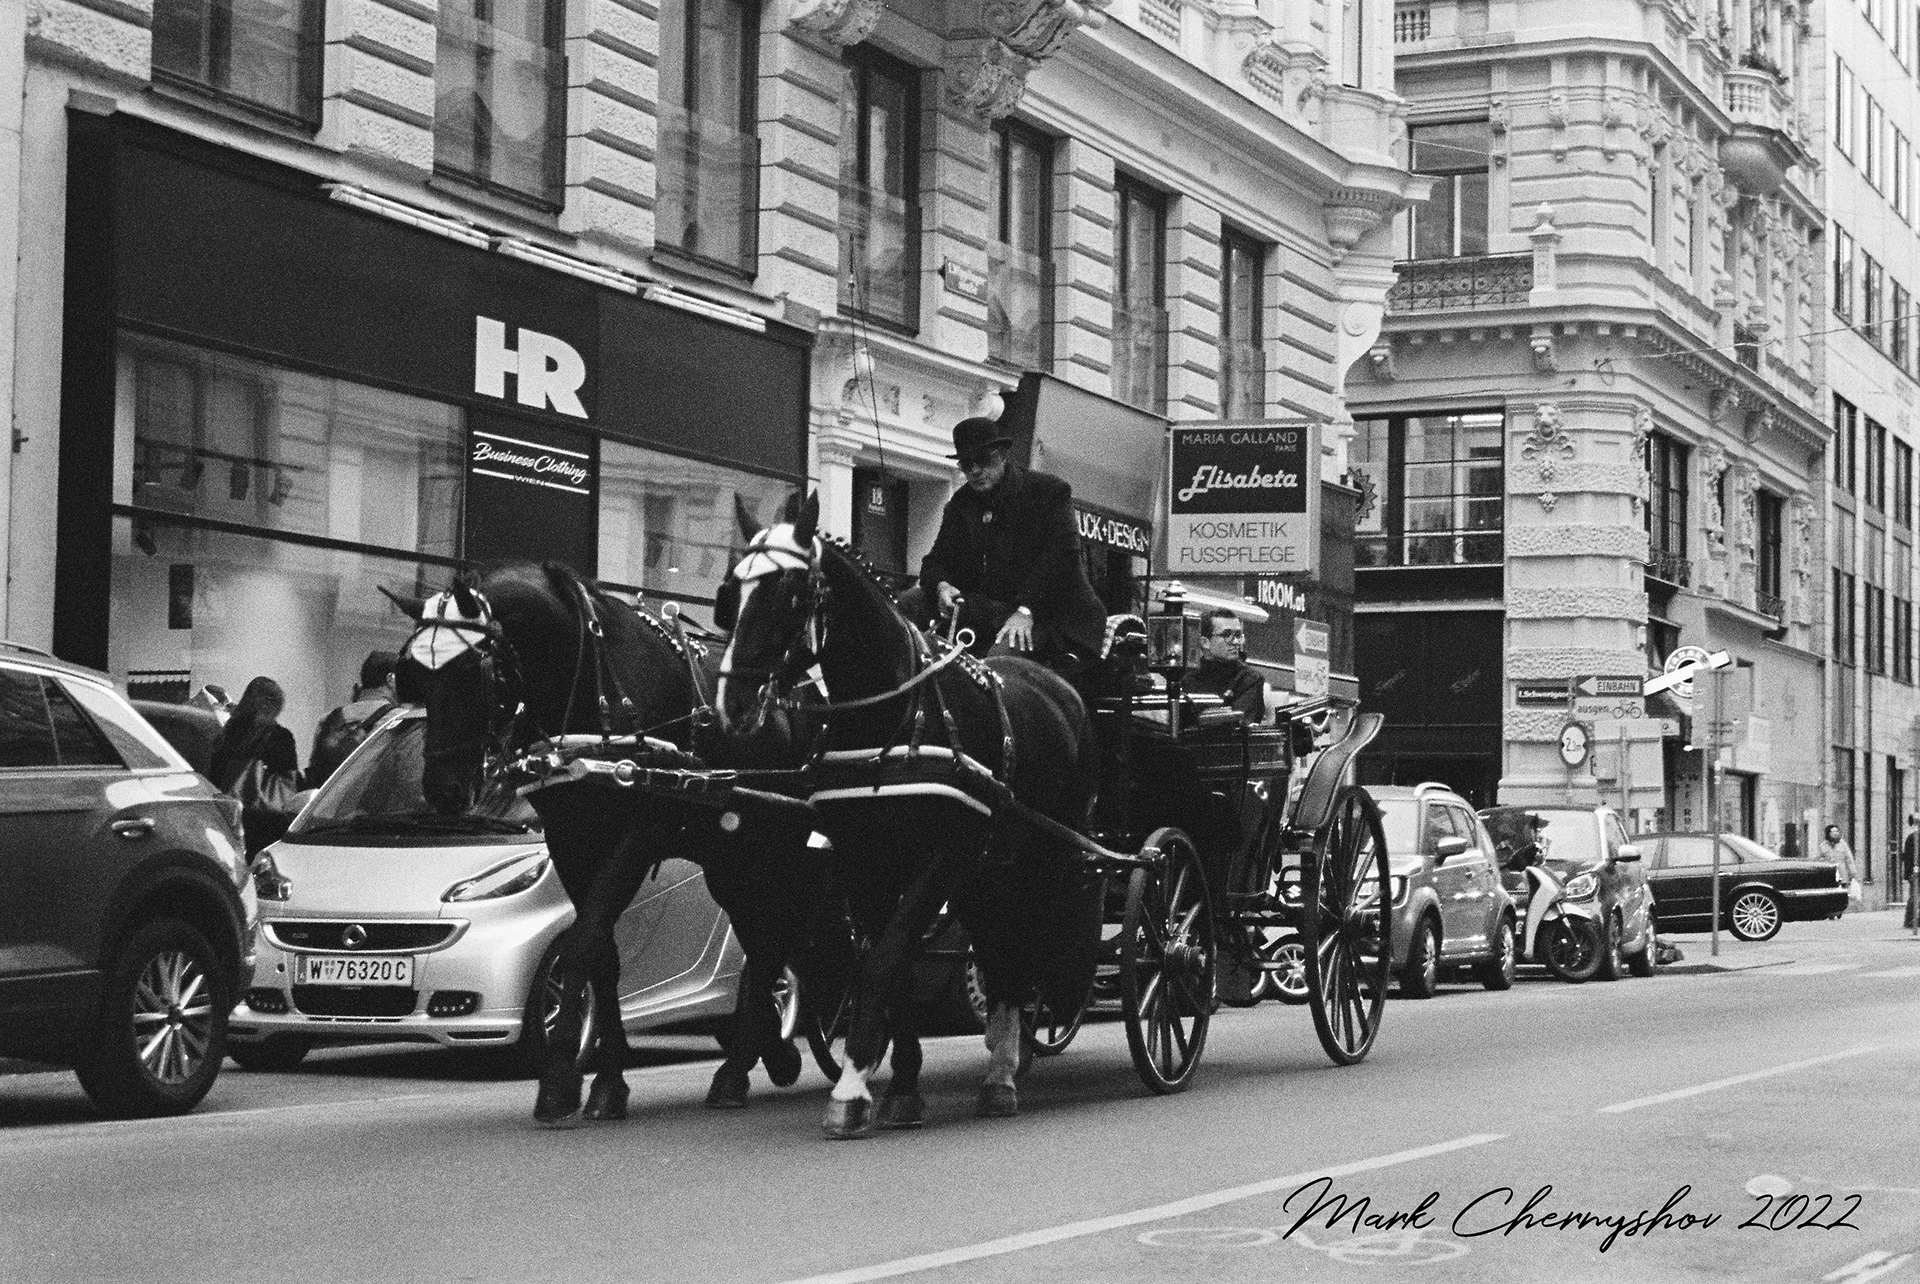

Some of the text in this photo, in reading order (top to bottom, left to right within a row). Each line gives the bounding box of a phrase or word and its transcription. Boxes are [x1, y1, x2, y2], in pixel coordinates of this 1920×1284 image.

[475, 315, 588, 419] HR
[1182, 431, 1298, 445] MARIA GALLAND
[472, 442, 589, 484] Business Clothing
[514, 474, 545, 487] WIEN
[1178, 464, 1298, 501] Elisabeta
[1189, 522, 1288, 539] KOSMETIK
[1179, 546, 1296, 563] FUSSPFLEGE
[1597, 681, 1636, 692] EINBAHN
